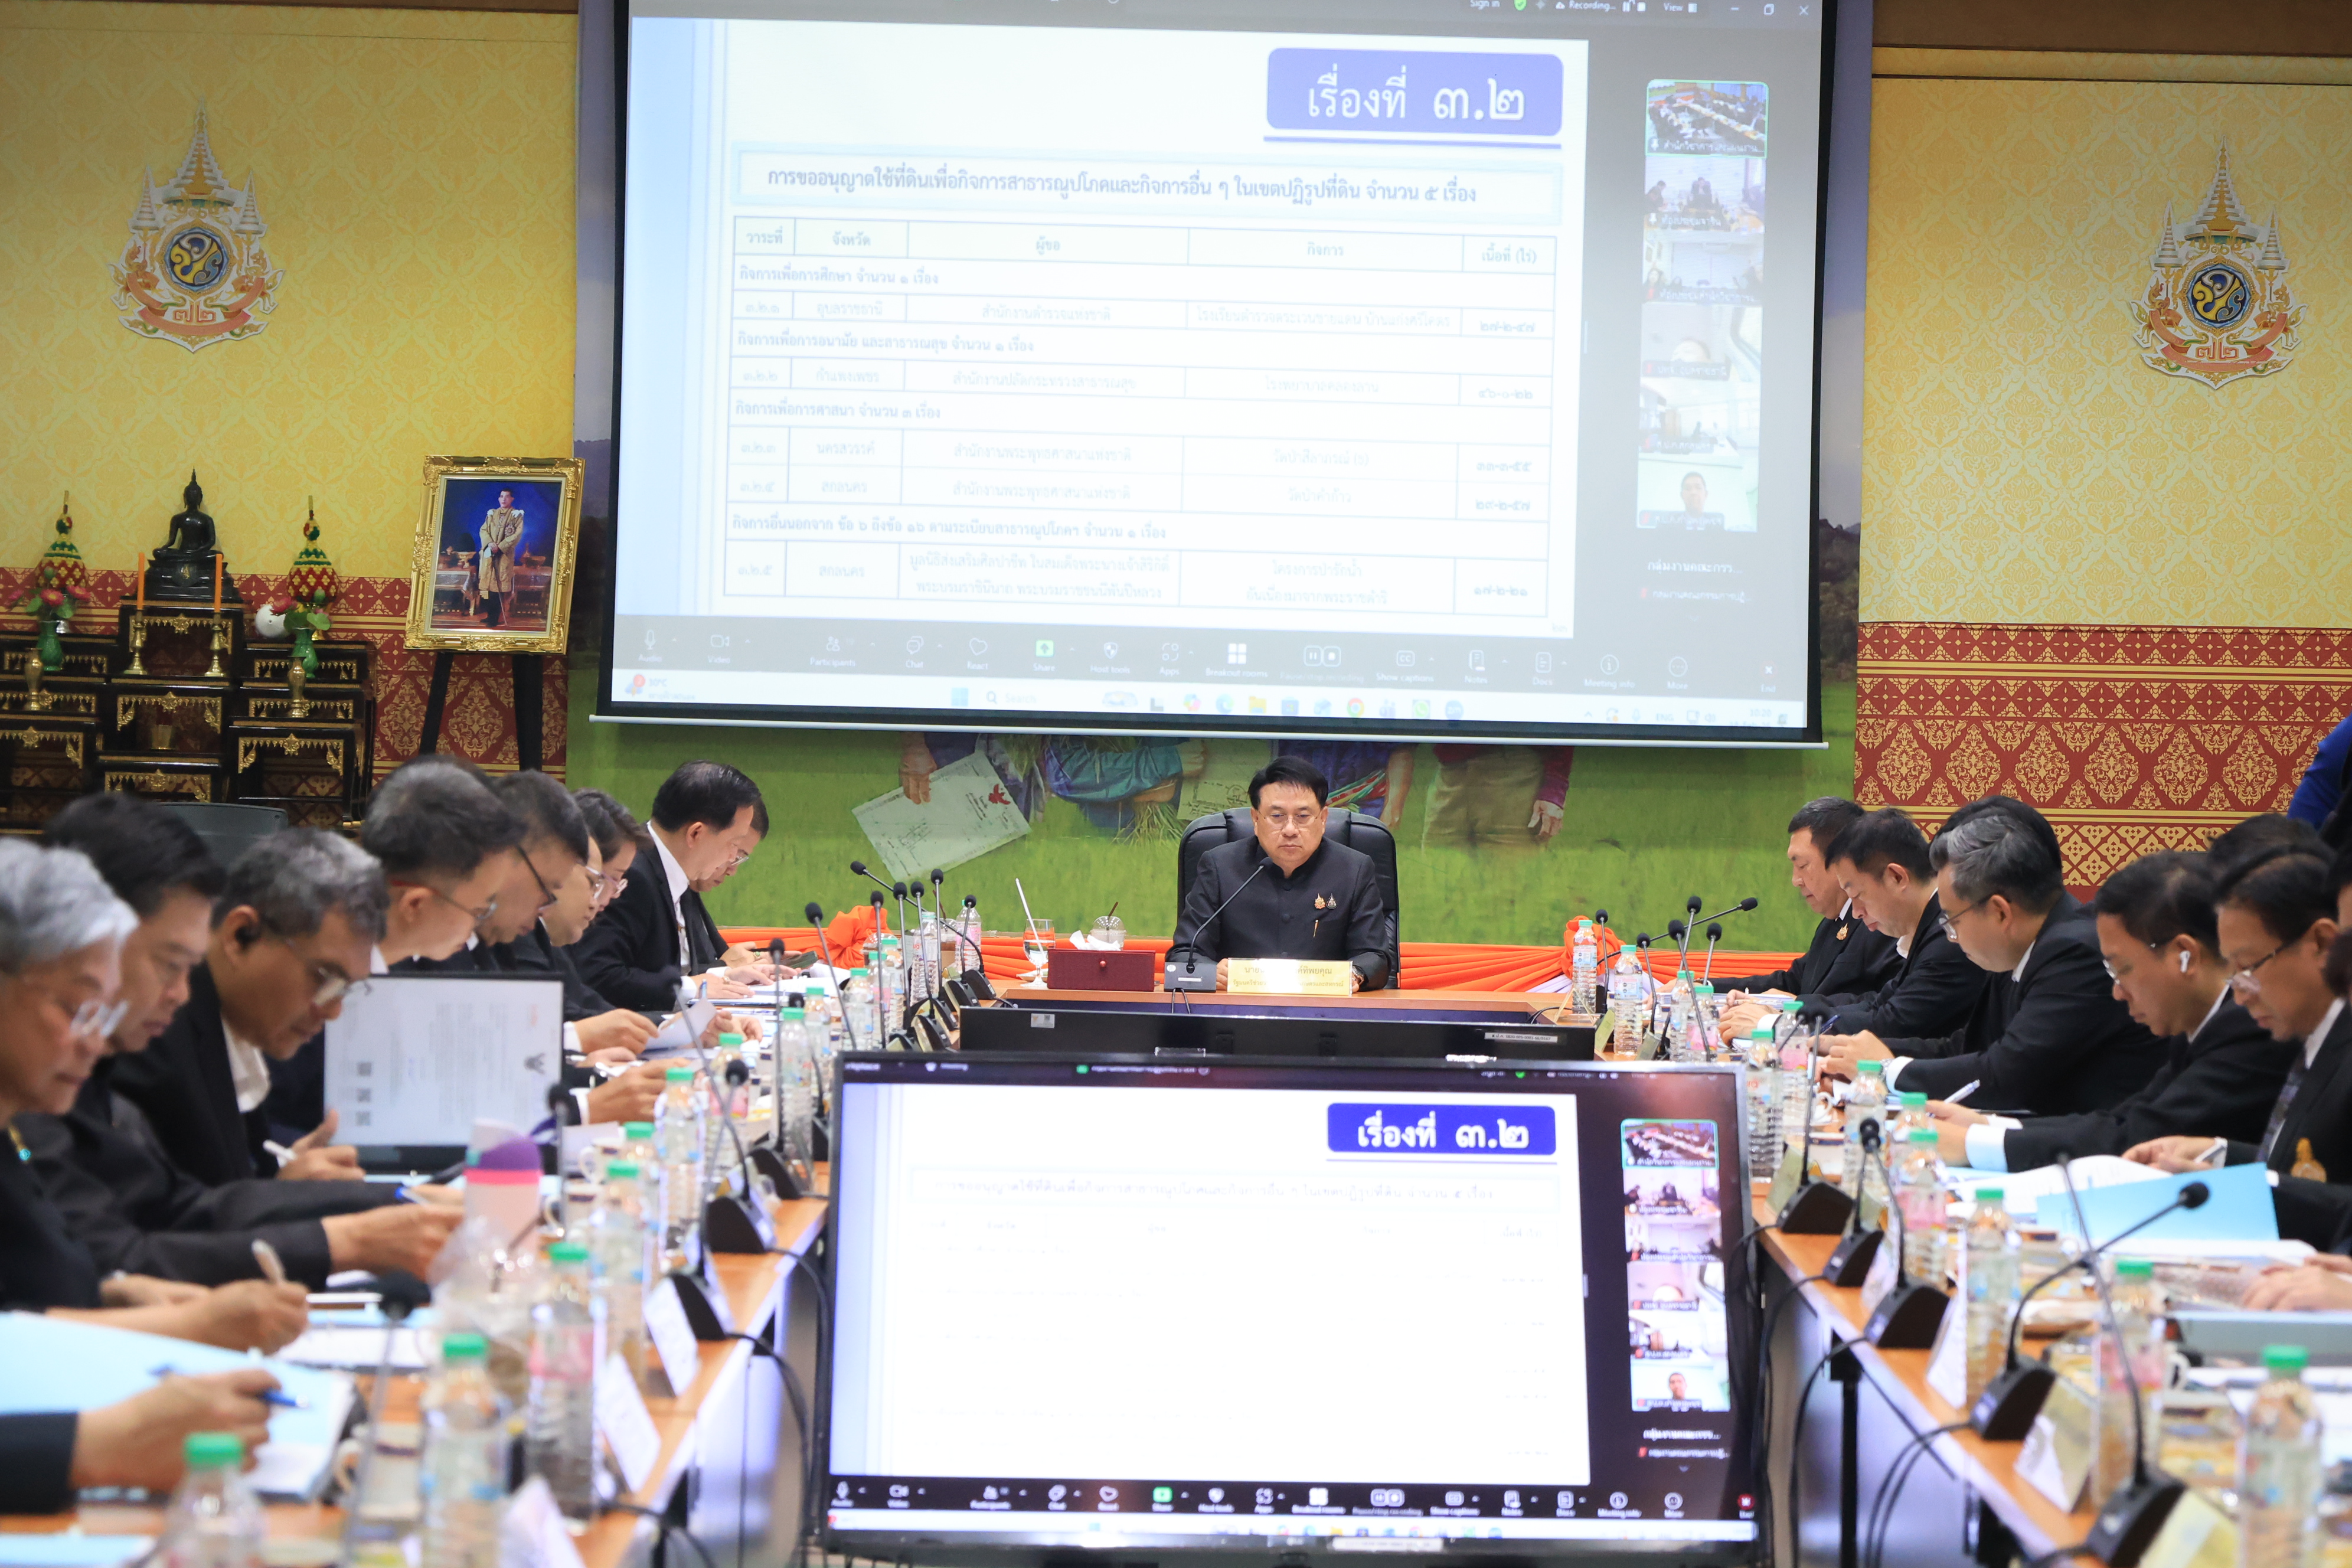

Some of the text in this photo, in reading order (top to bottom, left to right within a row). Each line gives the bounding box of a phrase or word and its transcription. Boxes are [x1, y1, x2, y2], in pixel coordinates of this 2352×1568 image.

[1308, 63, 1524, 120] เรื่องที่ ๓.๒
[767, 167, 1476, 206] การขออนุญาตใช้ที่ดินเพื่อกิจการสาธารณูปโภคและกิจการอื่น ๆ ในเขตปฏิรูปที่ดิน จำนวน ๕ เรื่อง
[746, 226, 1537, 264] วาระที่ จังหวัด ผู้ขอ กิจการ เนื้อที่ (ไร่)
[739, 262, 939, 285] กิจการเพื่อการศึกษา จำนวน ๑ เรื่อง
[815, 300, 886, 320] อุบลราชธานี
[981, 302, 1111, 321] สำนักงานตำรวจแห่งชาติ
[737, 327, 1034, 354] กิจการเพื่อการอนามัย และสาธารณสุข จำนวน ๑ เรื่อง
[816, 365, 880, 383] กำแพงเพชร
[735, 396, 941, 419] กิจการเพื่อการศาสนา จำนวน ๓ เรื่อง
[816, 440, 875, 455] นครสวรรค์
[821, 481, 867, 493] สกลนคร
[732, 511, 834, 530] กิจการอื่นนอกจาก
[837, 515, 854, 531] ข้อ
[1084, 521, 1123, 538] จำนวน
[1127, 529, 1136, 538] ๑
[1141, 520, 1167, 539] เรื่อง
[818, 565, 865, 577] สกลนคร
[707, 655, 730, 664] Video
[809, 657, 856, 668] Participants
[906, 659, 923, 668] Chat
[966, 661, 989, 671] React
[1033, 662, 1055, 672] Share
[1090, 665, 1130, 675] Host tools
[1159, 667, 1180, 677] Apps
[1205, 667, 1268, 678] Breakout rooms
[1376, 672, 1435, 684] Show captions
[1465, 674, 1488, 684] Notes
[1532, 677, 1554, 686] Docs
[1584, 678, 1635, 690] Meeting info
[1667, 681, 1688, 690] More
[1760, 683, 1776, 693] End
[1358, 1109, 1529, 1149] เรื่องที่ ๓.๒
